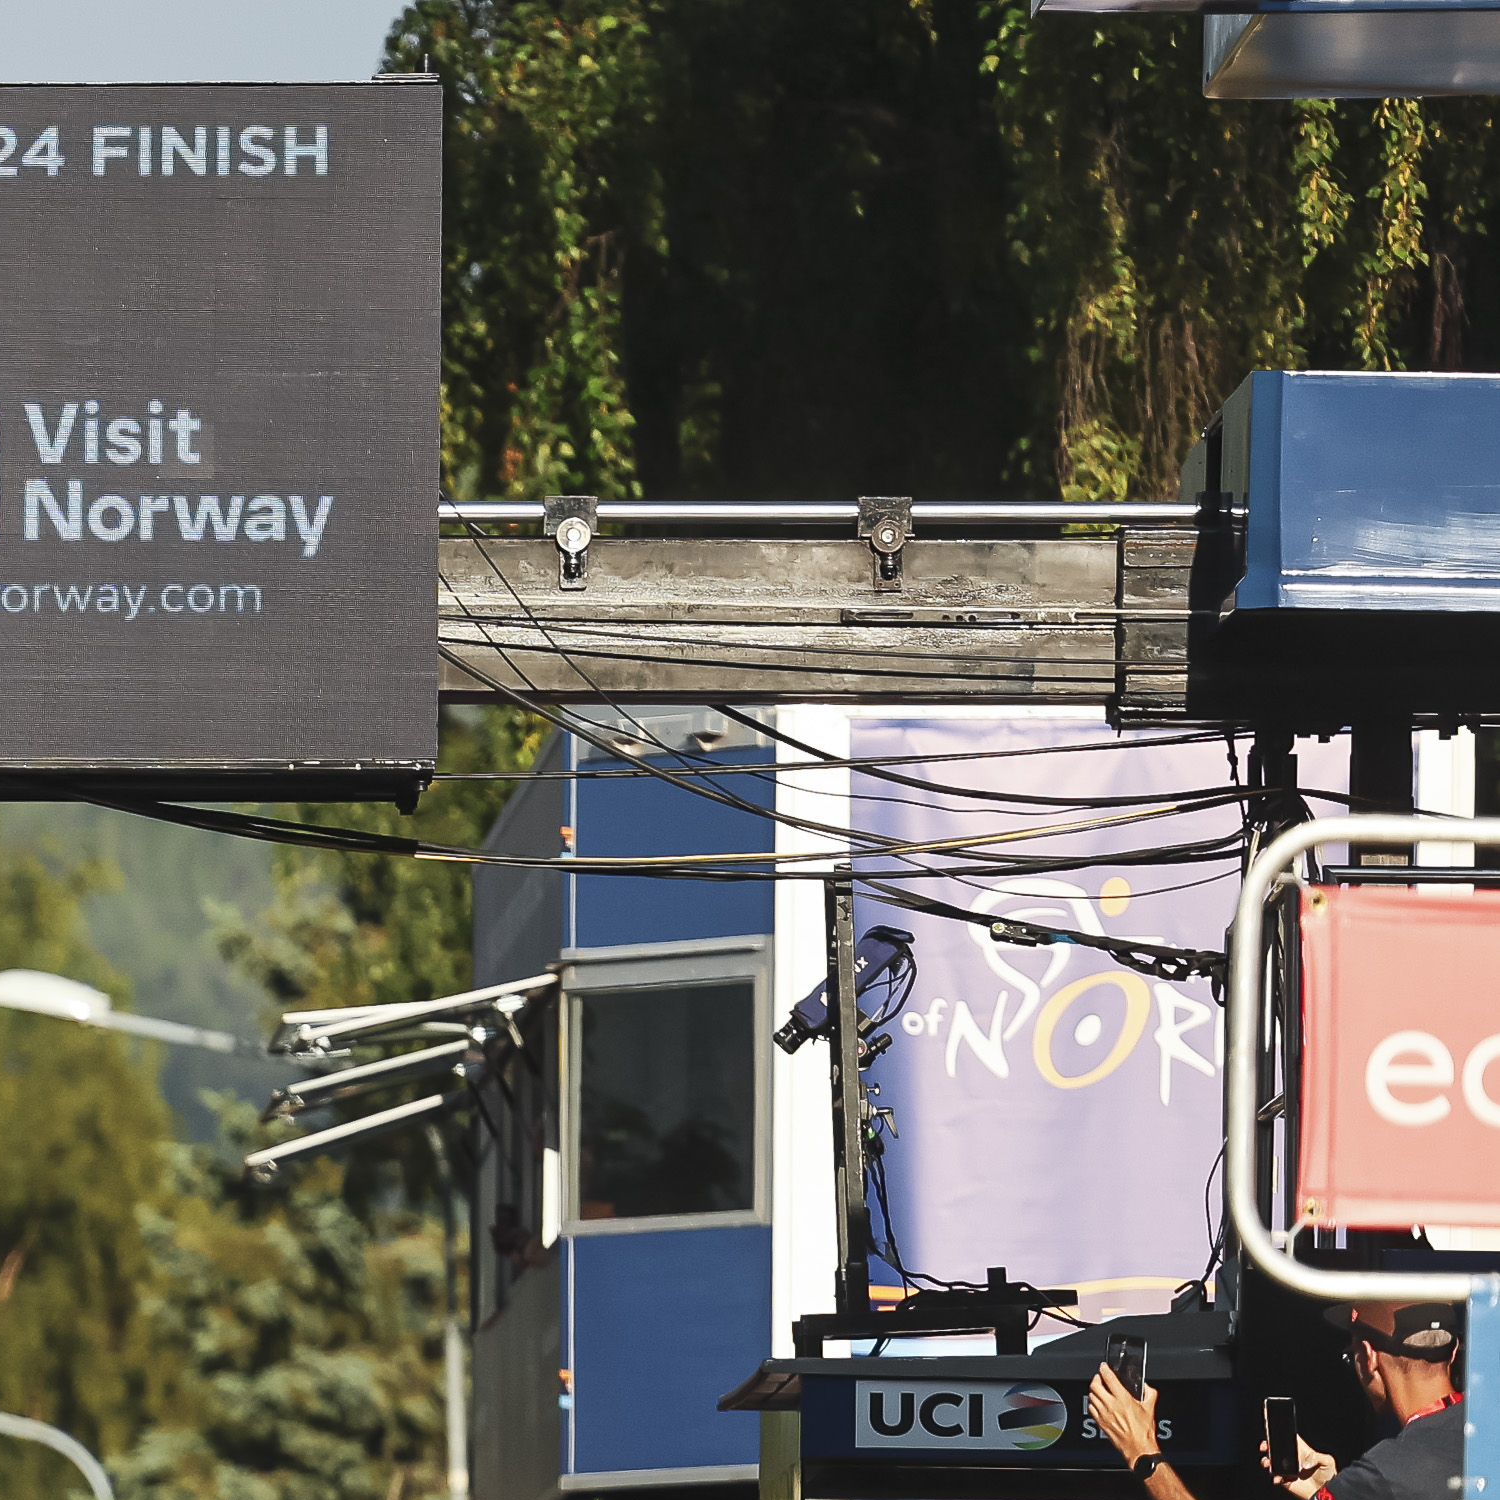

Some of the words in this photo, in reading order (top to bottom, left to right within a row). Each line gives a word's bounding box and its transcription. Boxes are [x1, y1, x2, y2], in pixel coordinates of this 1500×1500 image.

[92, 125, 329, 177] FINISH
[23, 400, 201, 464] Visit
[23, 478, 333, 557] Norway
[868, 1392, 984, 1437] UCI
